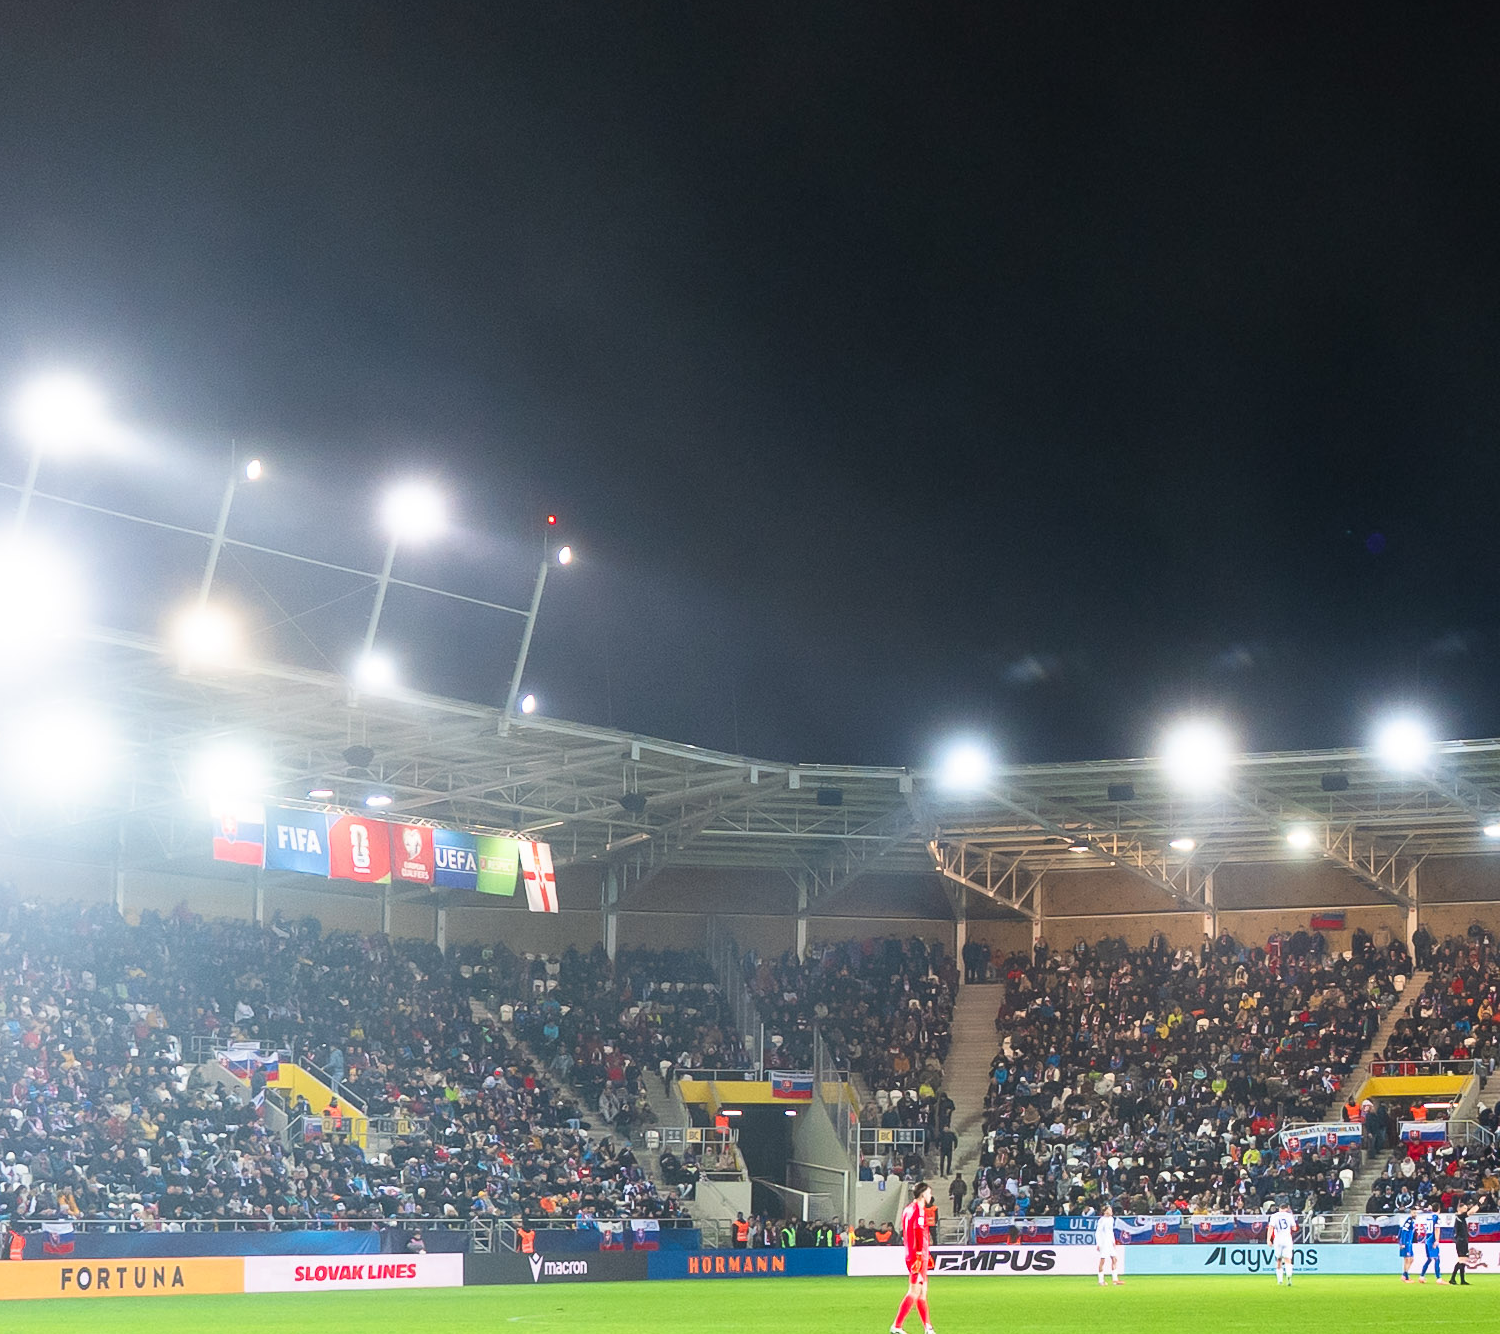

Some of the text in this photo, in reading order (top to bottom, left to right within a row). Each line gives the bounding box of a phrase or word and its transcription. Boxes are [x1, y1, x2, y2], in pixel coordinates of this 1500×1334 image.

[277, 824, 322, 855] FIFA
[435, 848, 477, 871] UEFA
[1278, 1219, 1287, 1229] 13
[1059, 1233, 1096, 1244] STRO
[544, 1259, 588, 1275] macron
[930, 1250, 1057, 1271] TEMPUS
[1231, 1249, 1318, 1273] ayvns
[61, 1266, 185, 1290] FORTUNA
[294, 1264, 417, 1282] SLOVAK LINES
